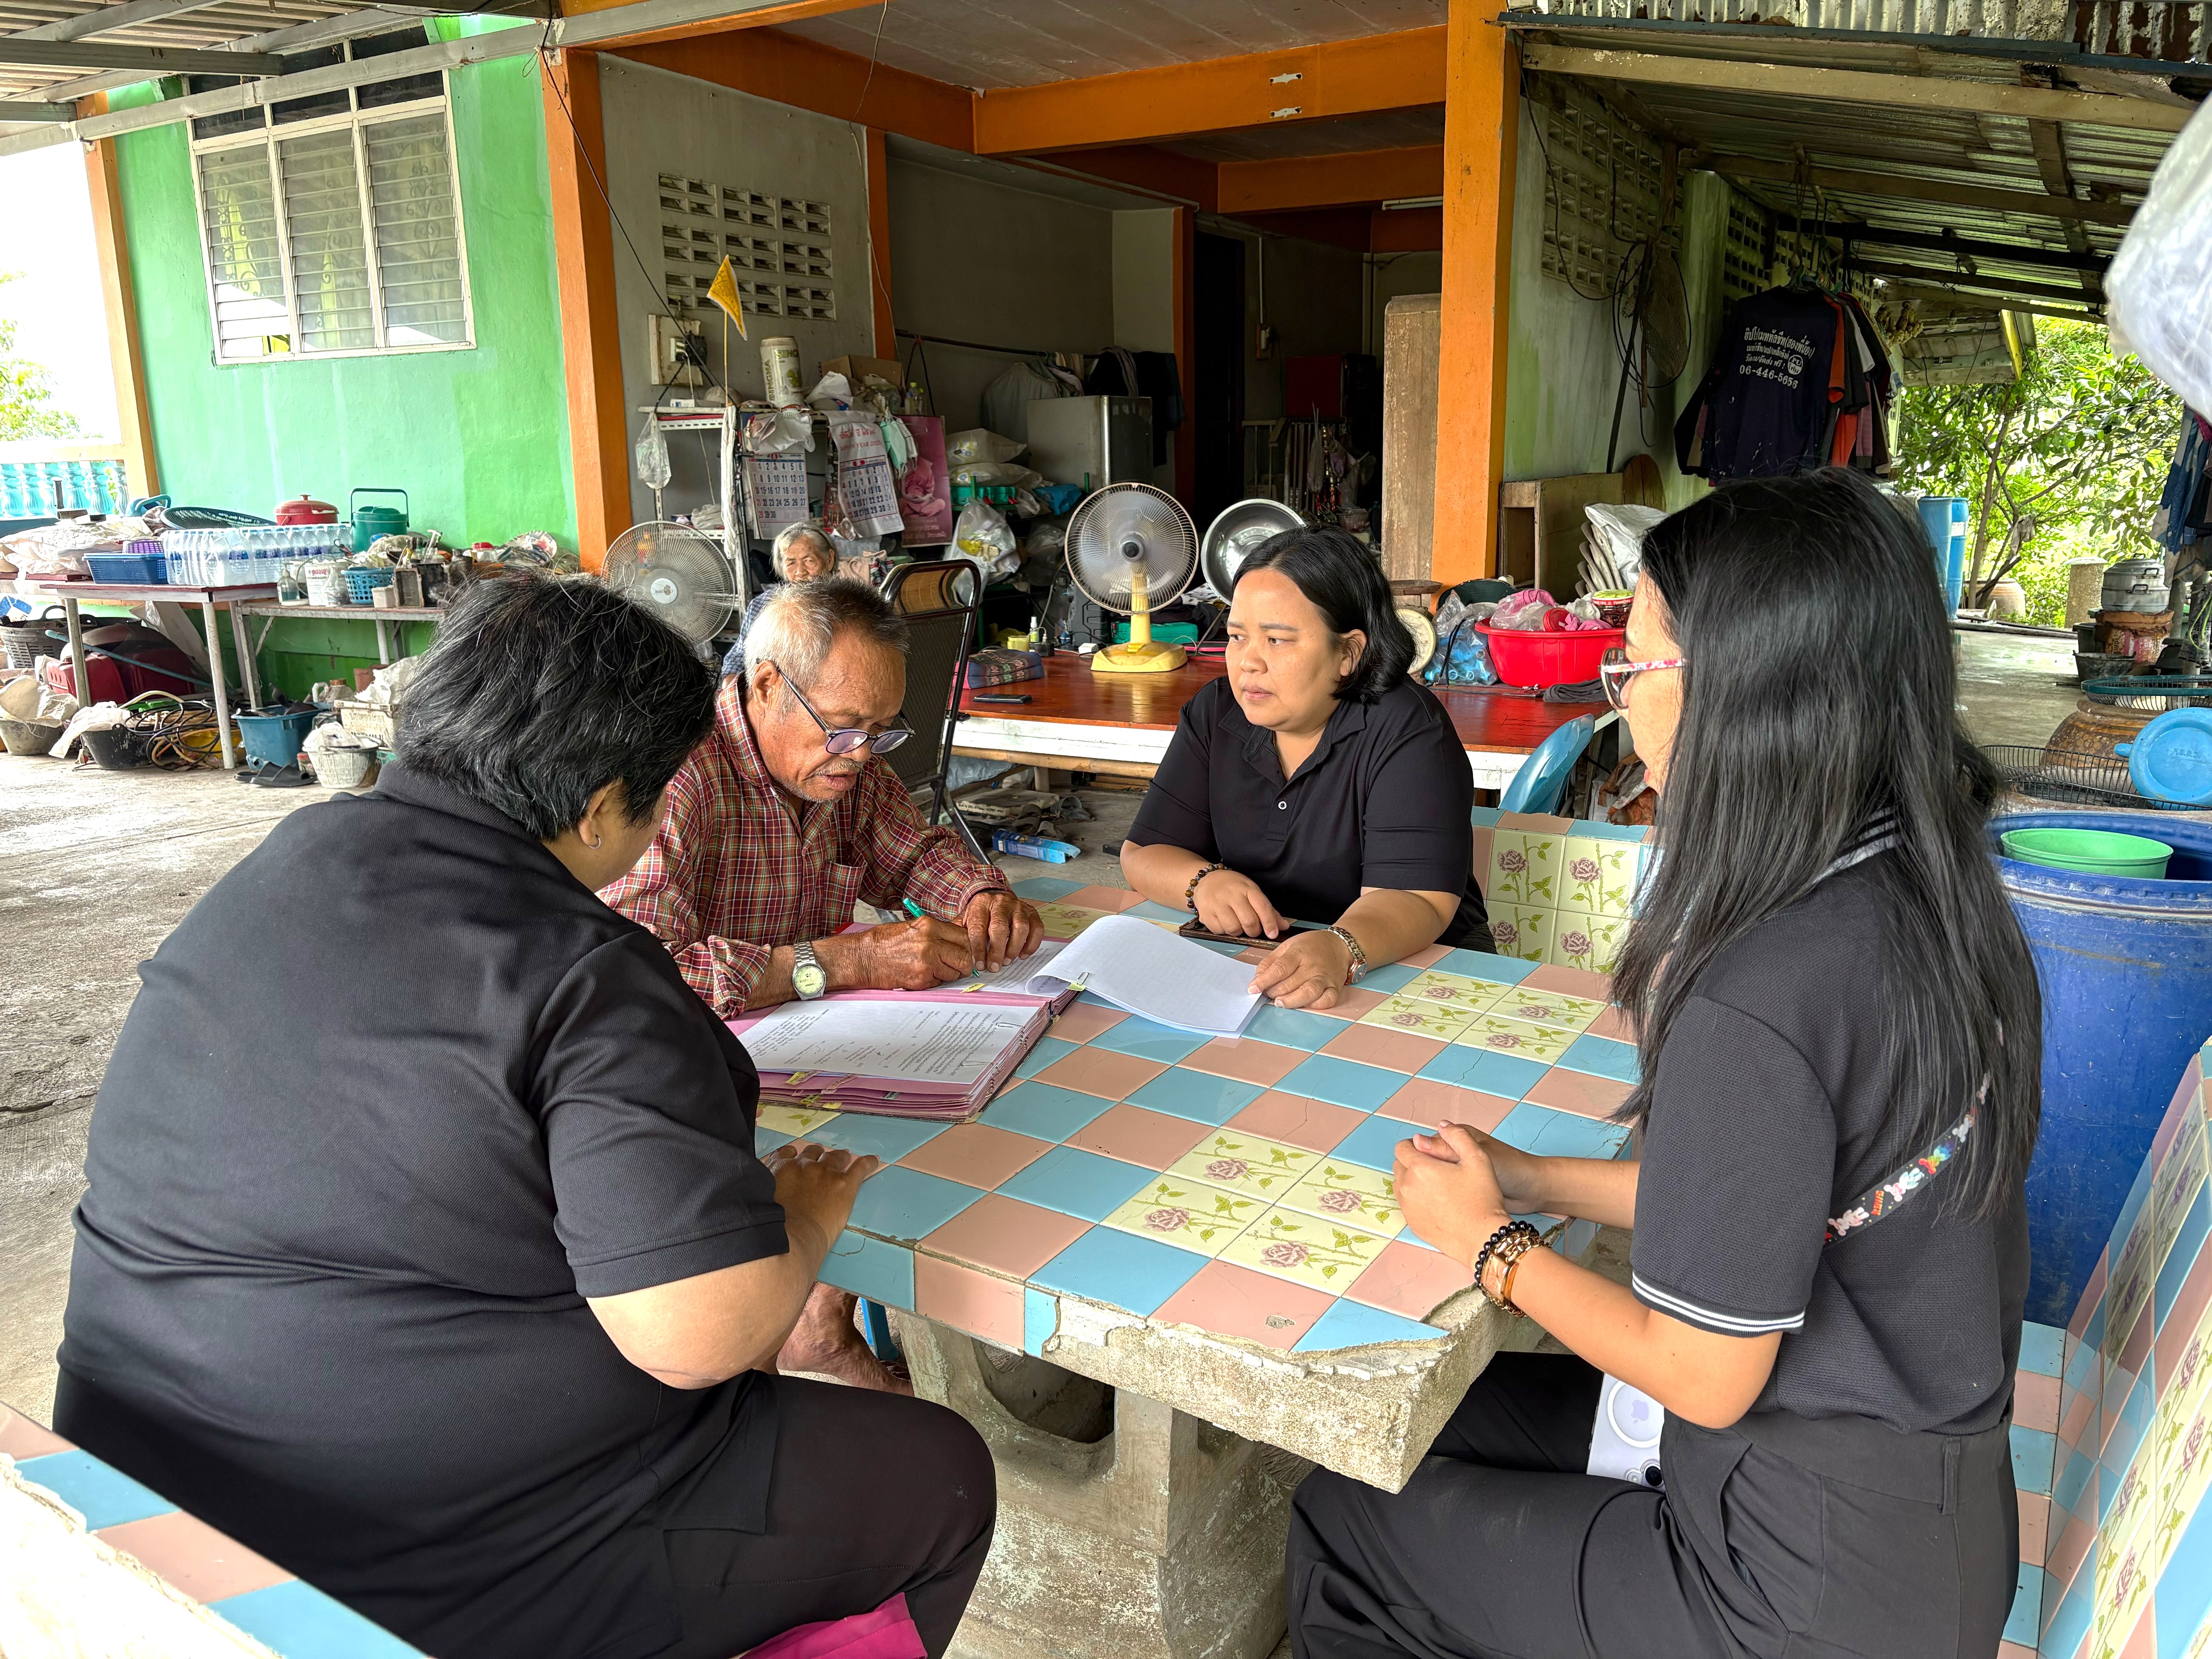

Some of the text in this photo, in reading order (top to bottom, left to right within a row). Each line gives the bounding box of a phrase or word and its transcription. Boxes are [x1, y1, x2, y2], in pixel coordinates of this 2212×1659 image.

[1791, 357, 1802, 366] PU
[764, 359, 775, 401] SINGHA
[1740, 365, 1798, 389] 06-446-5656
[761, 486, 766, 495] 15
[783, 486, 789, 495] 18
